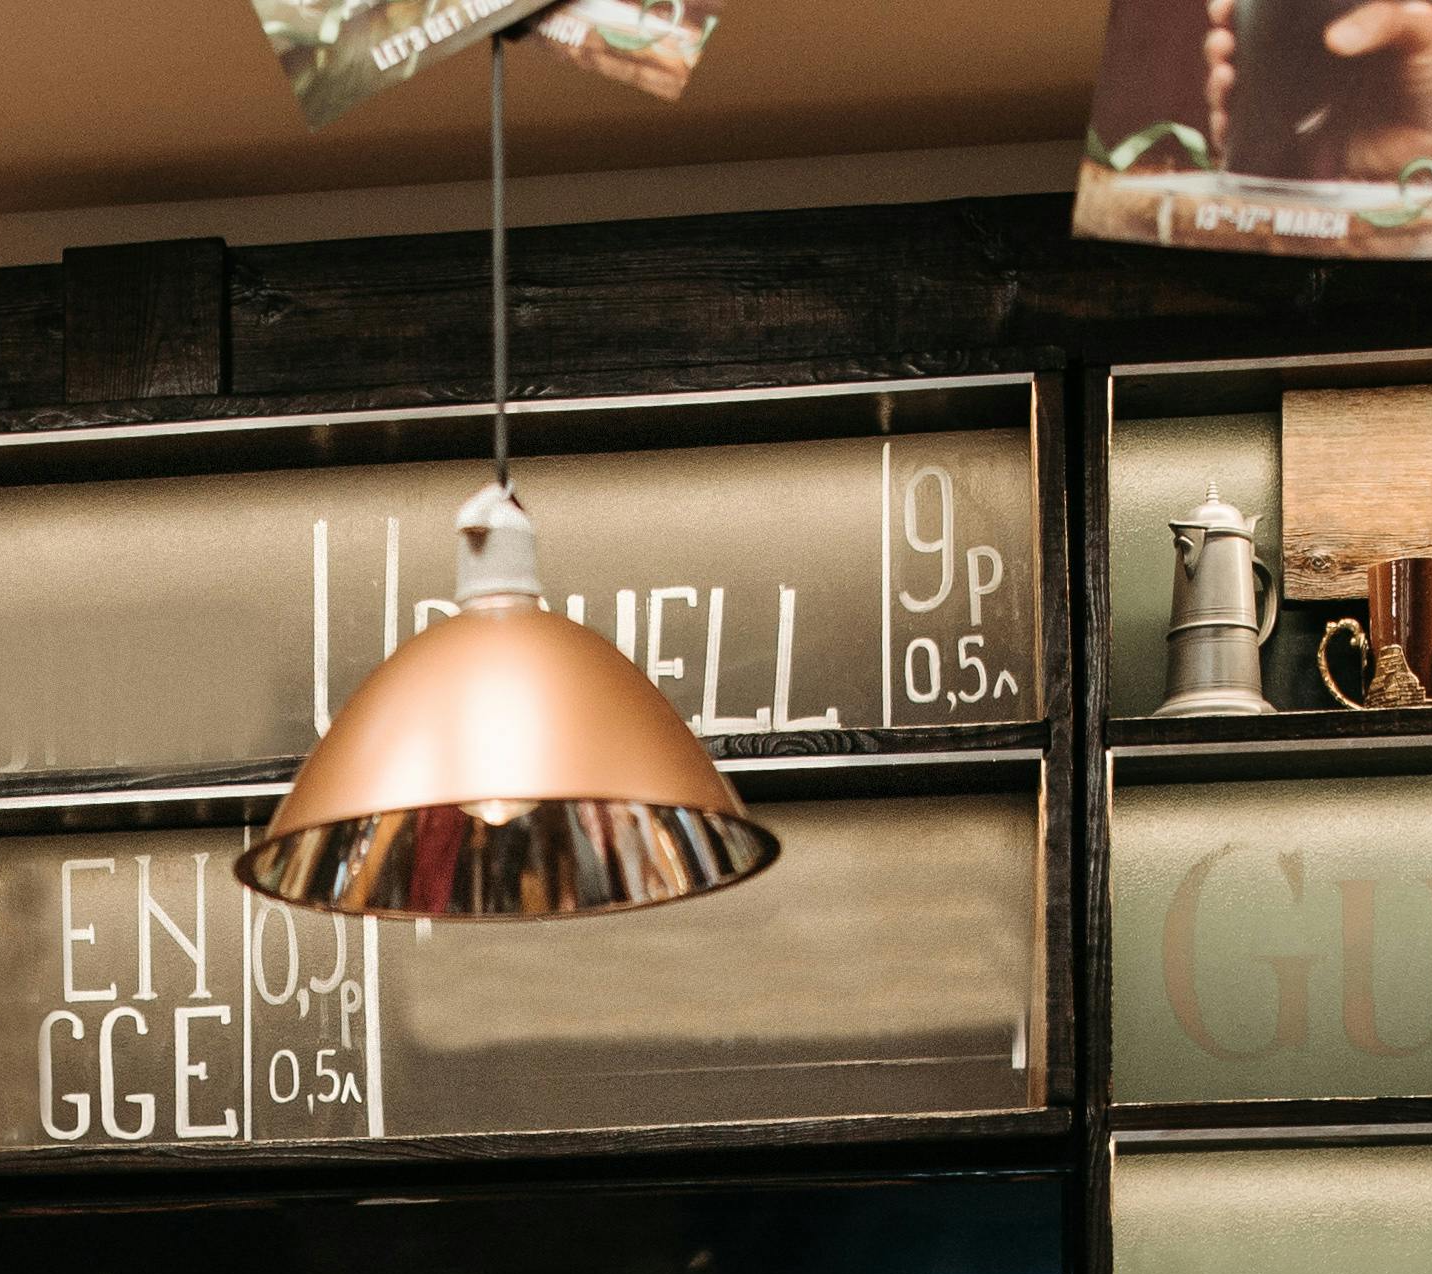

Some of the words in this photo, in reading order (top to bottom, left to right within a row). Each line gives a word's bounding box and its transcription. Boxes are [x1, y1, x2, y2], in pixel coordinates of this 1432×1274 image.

[371, 24, 426, 71] LET'S
[423, 7, 464, 44] GET
[1272, 206, 1349, 240] MARCH
[313, 516, 841, 741] UELL
[61, 851, 213, 1003] EN
[38, 1005, 239, 1141] GGE
